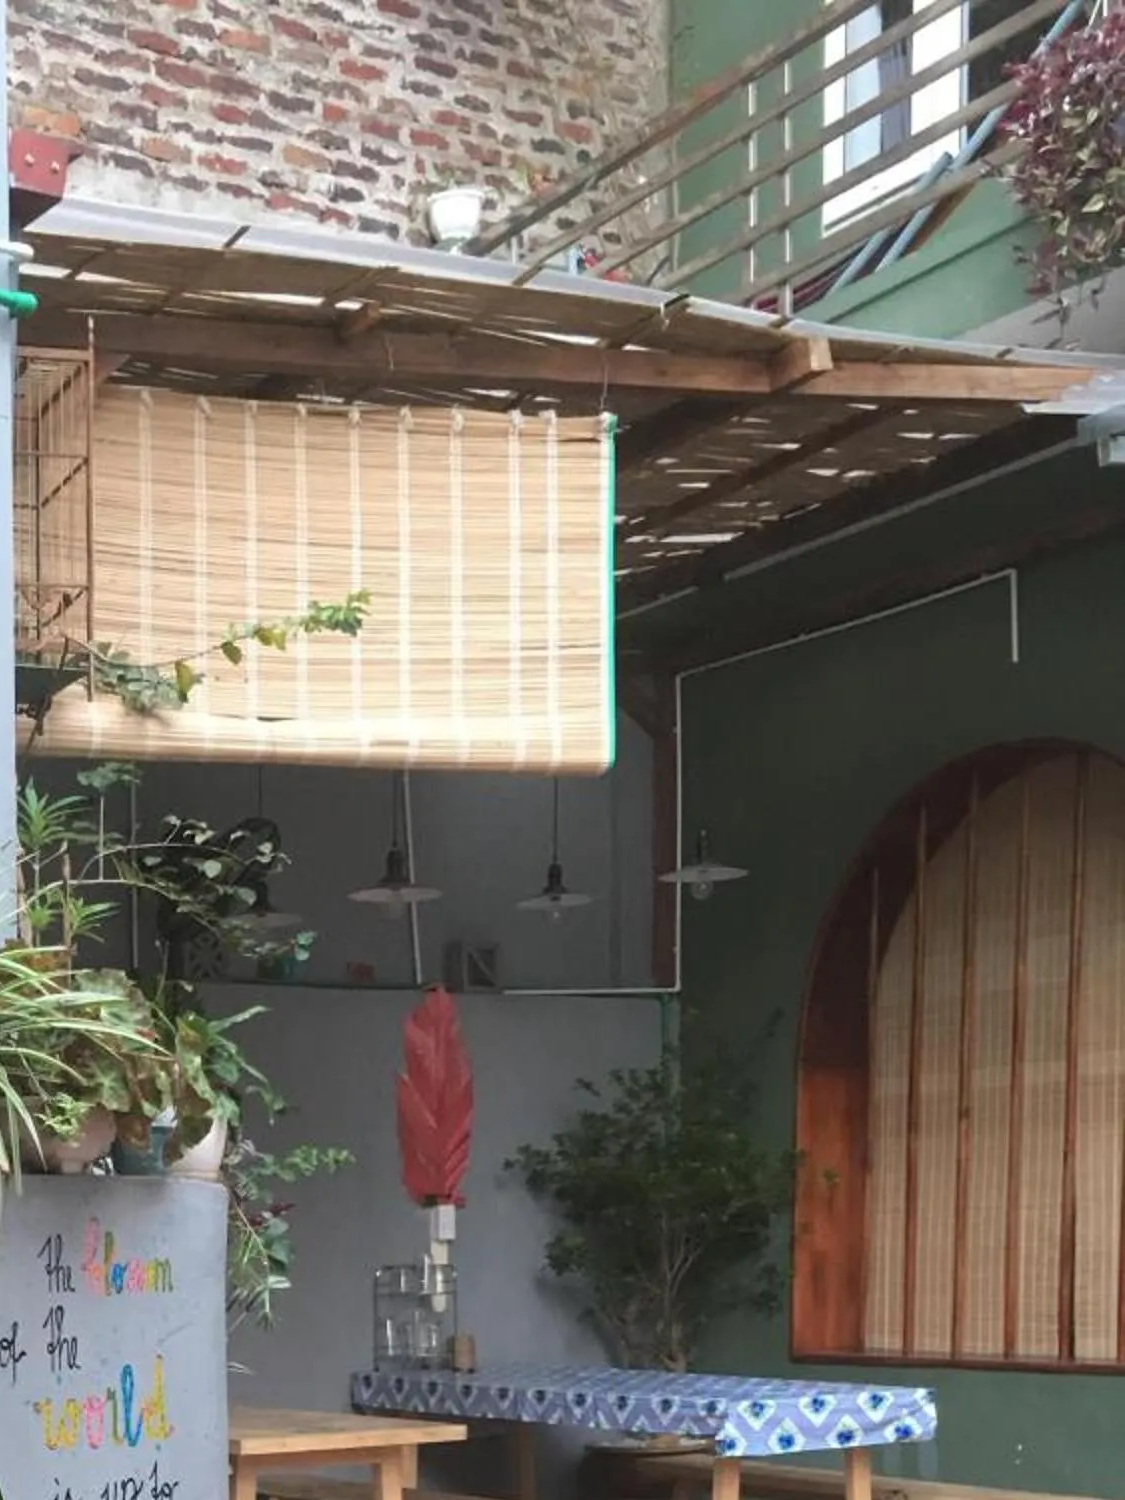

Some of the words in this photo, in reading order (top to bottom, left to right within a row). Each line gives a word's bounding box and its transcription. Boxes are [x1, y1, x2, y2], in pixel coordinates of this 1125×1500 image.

[37, 1233, 76, 1293] the
[42, 1305, 81, 1373] the
[33, 1354, 174, 1450] world
